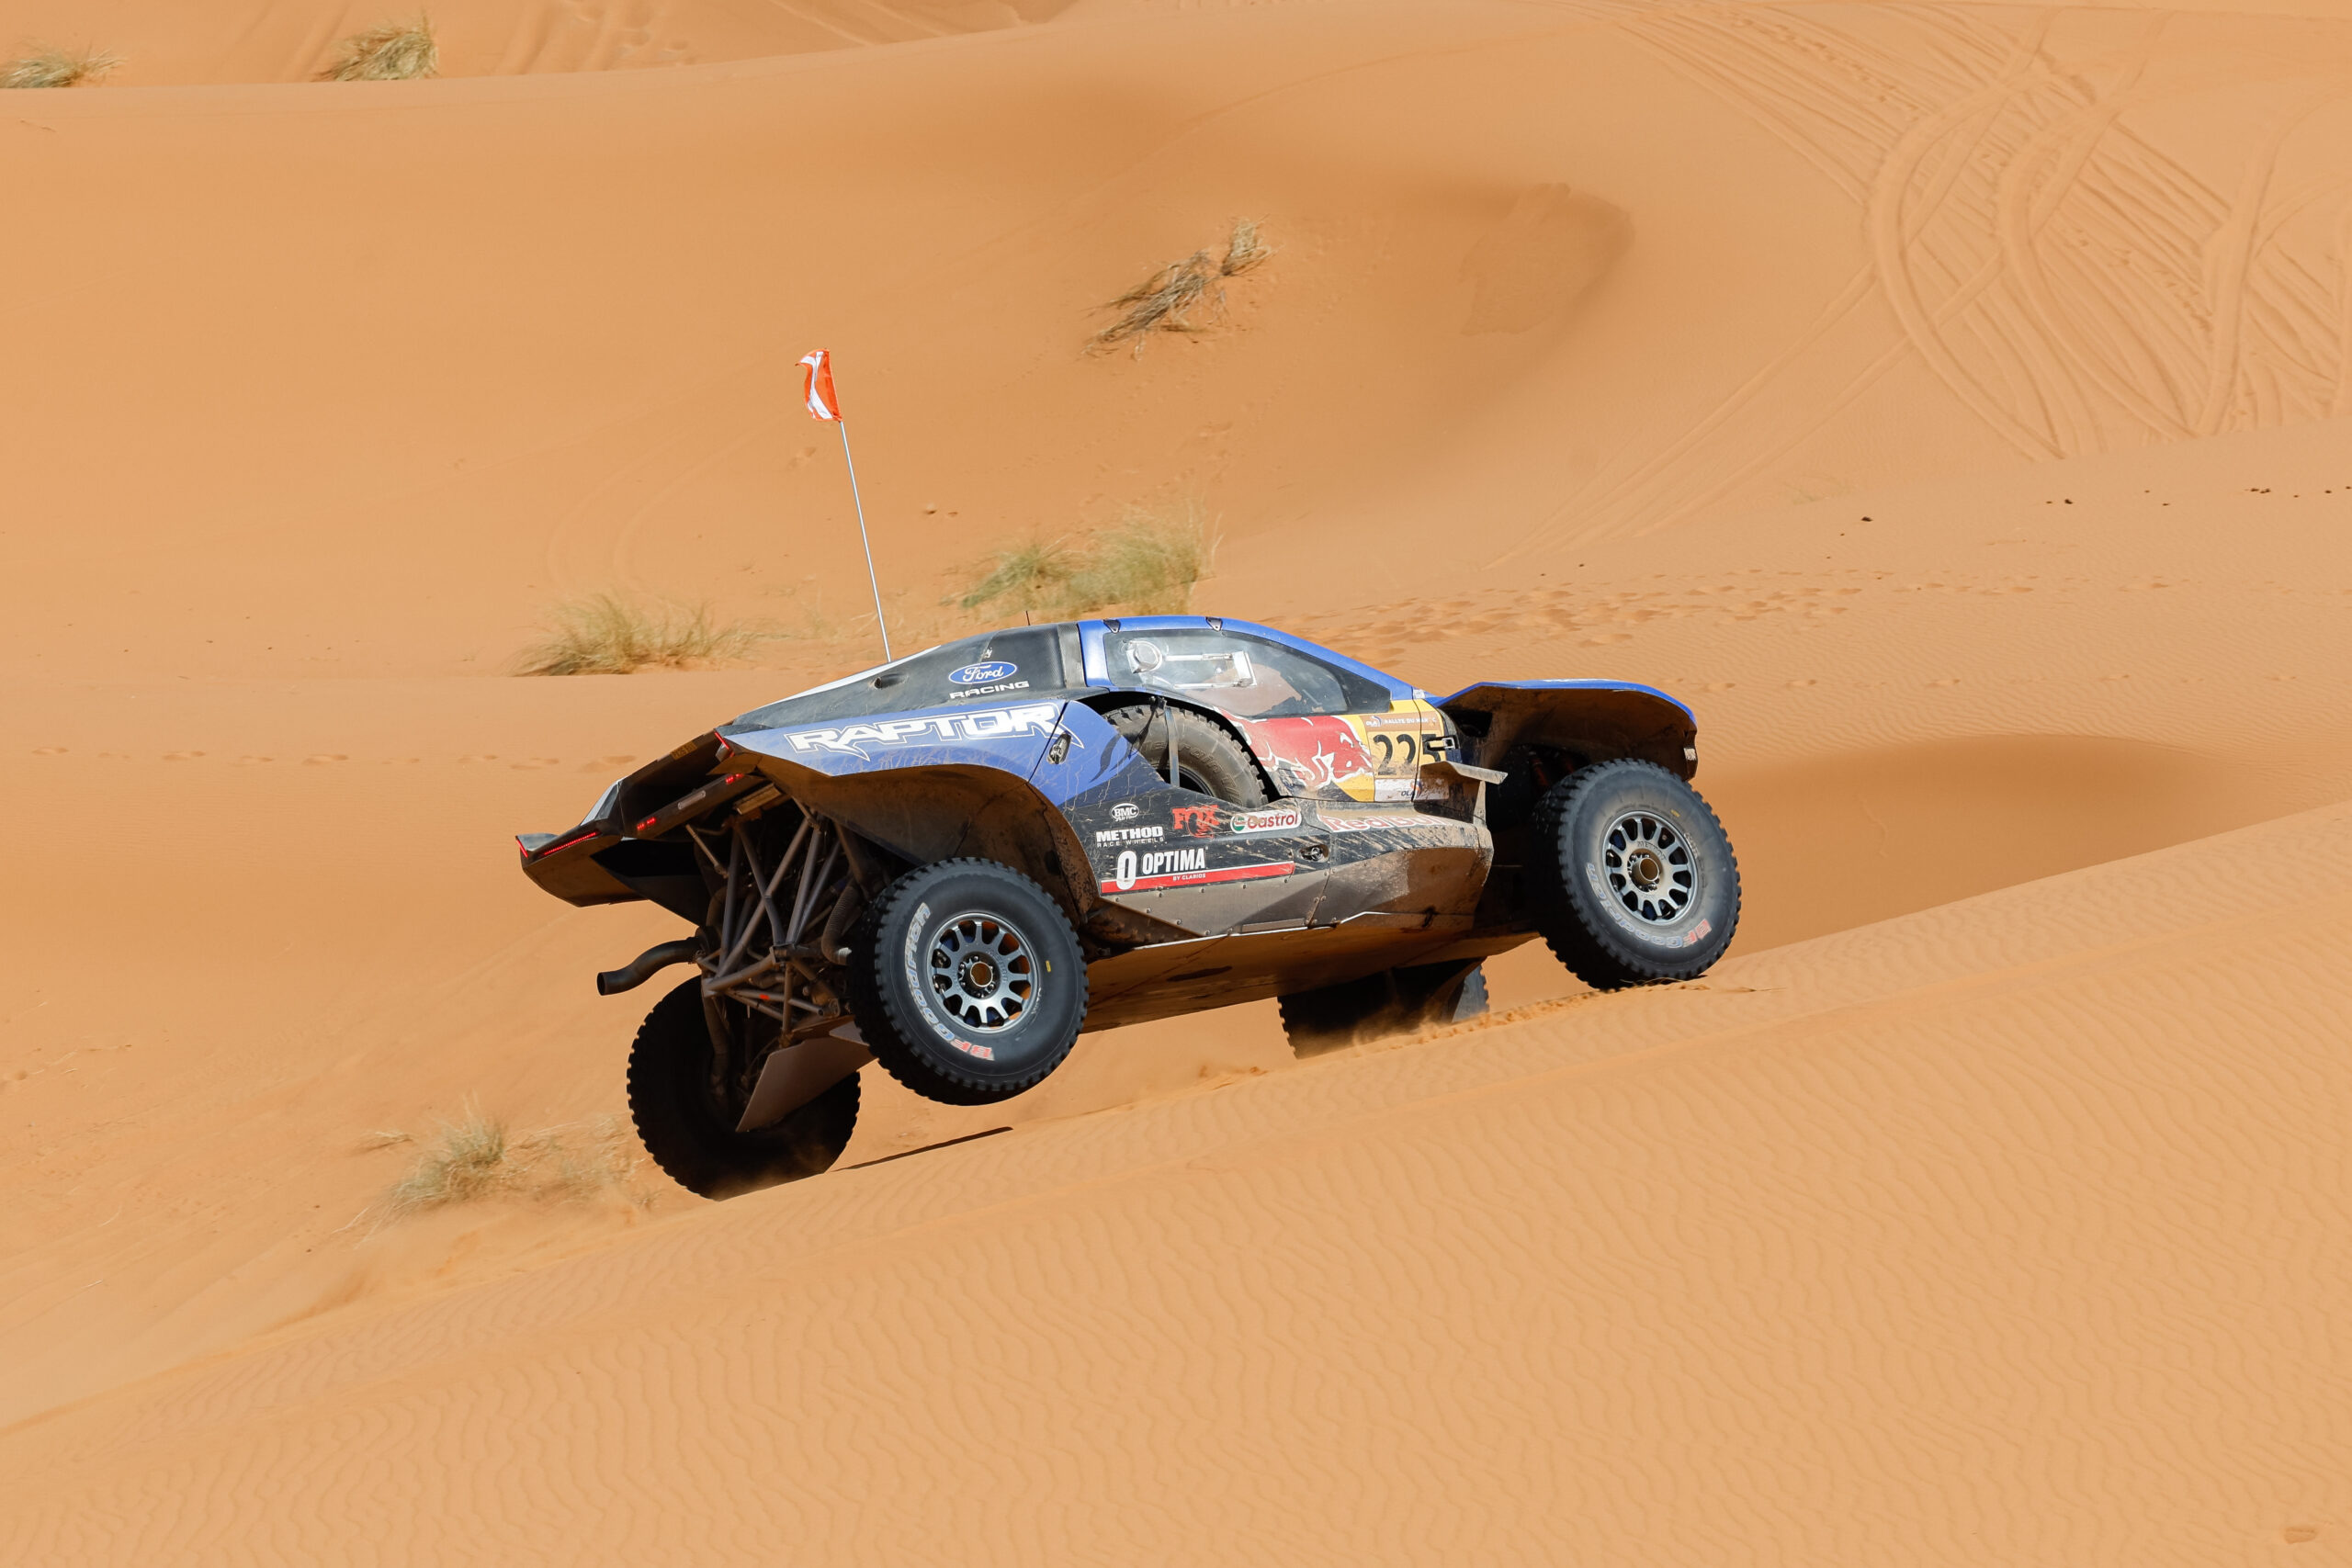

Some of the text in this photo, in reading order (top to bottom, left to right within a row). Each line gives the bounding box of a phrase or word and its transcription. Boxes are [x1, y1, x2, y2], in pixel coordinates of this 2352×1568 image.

[962, 664, 1004, 682] Ford
[949, 681, 1030, 699] RACING
[784, 702, 1085, 761] RAPTOR
[1373, 733, 1442, 775] 225
[1114, 807, 1137, 817] BMC
[1248, 813, 1298, 829] Castrol
[1171, 805, 1221, 839] FOX
[1317, 814, 1394, 832] Red
[1095, 826, 1164, 842] METHOD
[1096, 837, 1165, 849] RACE WHEELS
[1142, 848, 1205, 875] OPTIMA
[905, 901, 996, 1062] BFGoodrich
